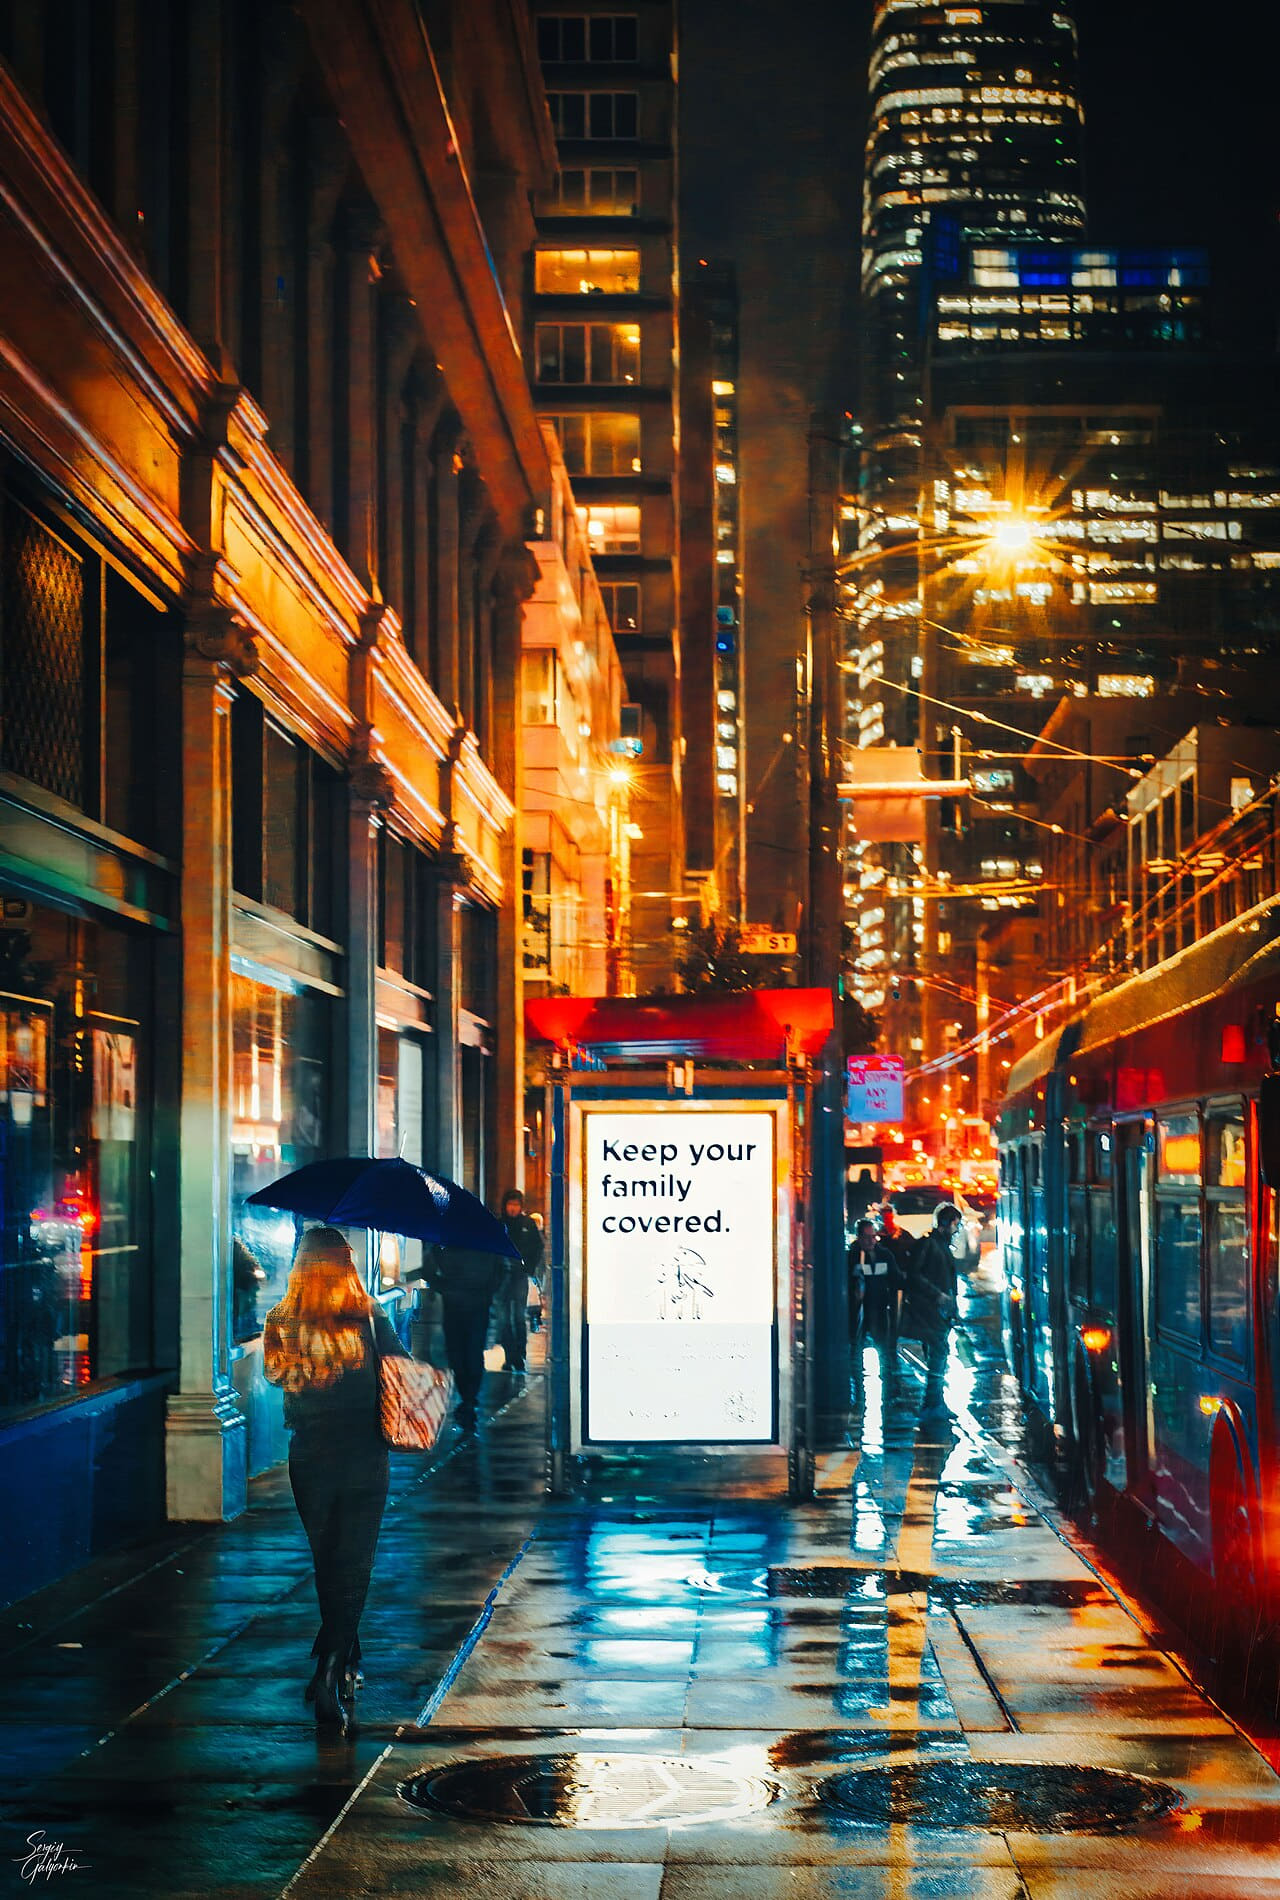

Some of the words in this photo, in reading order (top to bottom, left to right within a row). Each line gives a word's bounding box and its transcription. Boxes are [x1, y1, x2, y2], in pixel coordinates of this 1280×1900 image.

[768, 936, 790, 949] ST
[866, 1088, 887, 1097] ANY
[603, 1139, 678, 1166] Keep
[689, 1144, 757, 1166] your
[602, 1174, 692, 1202] family
[602, 1209, 730, 1233] covered.
